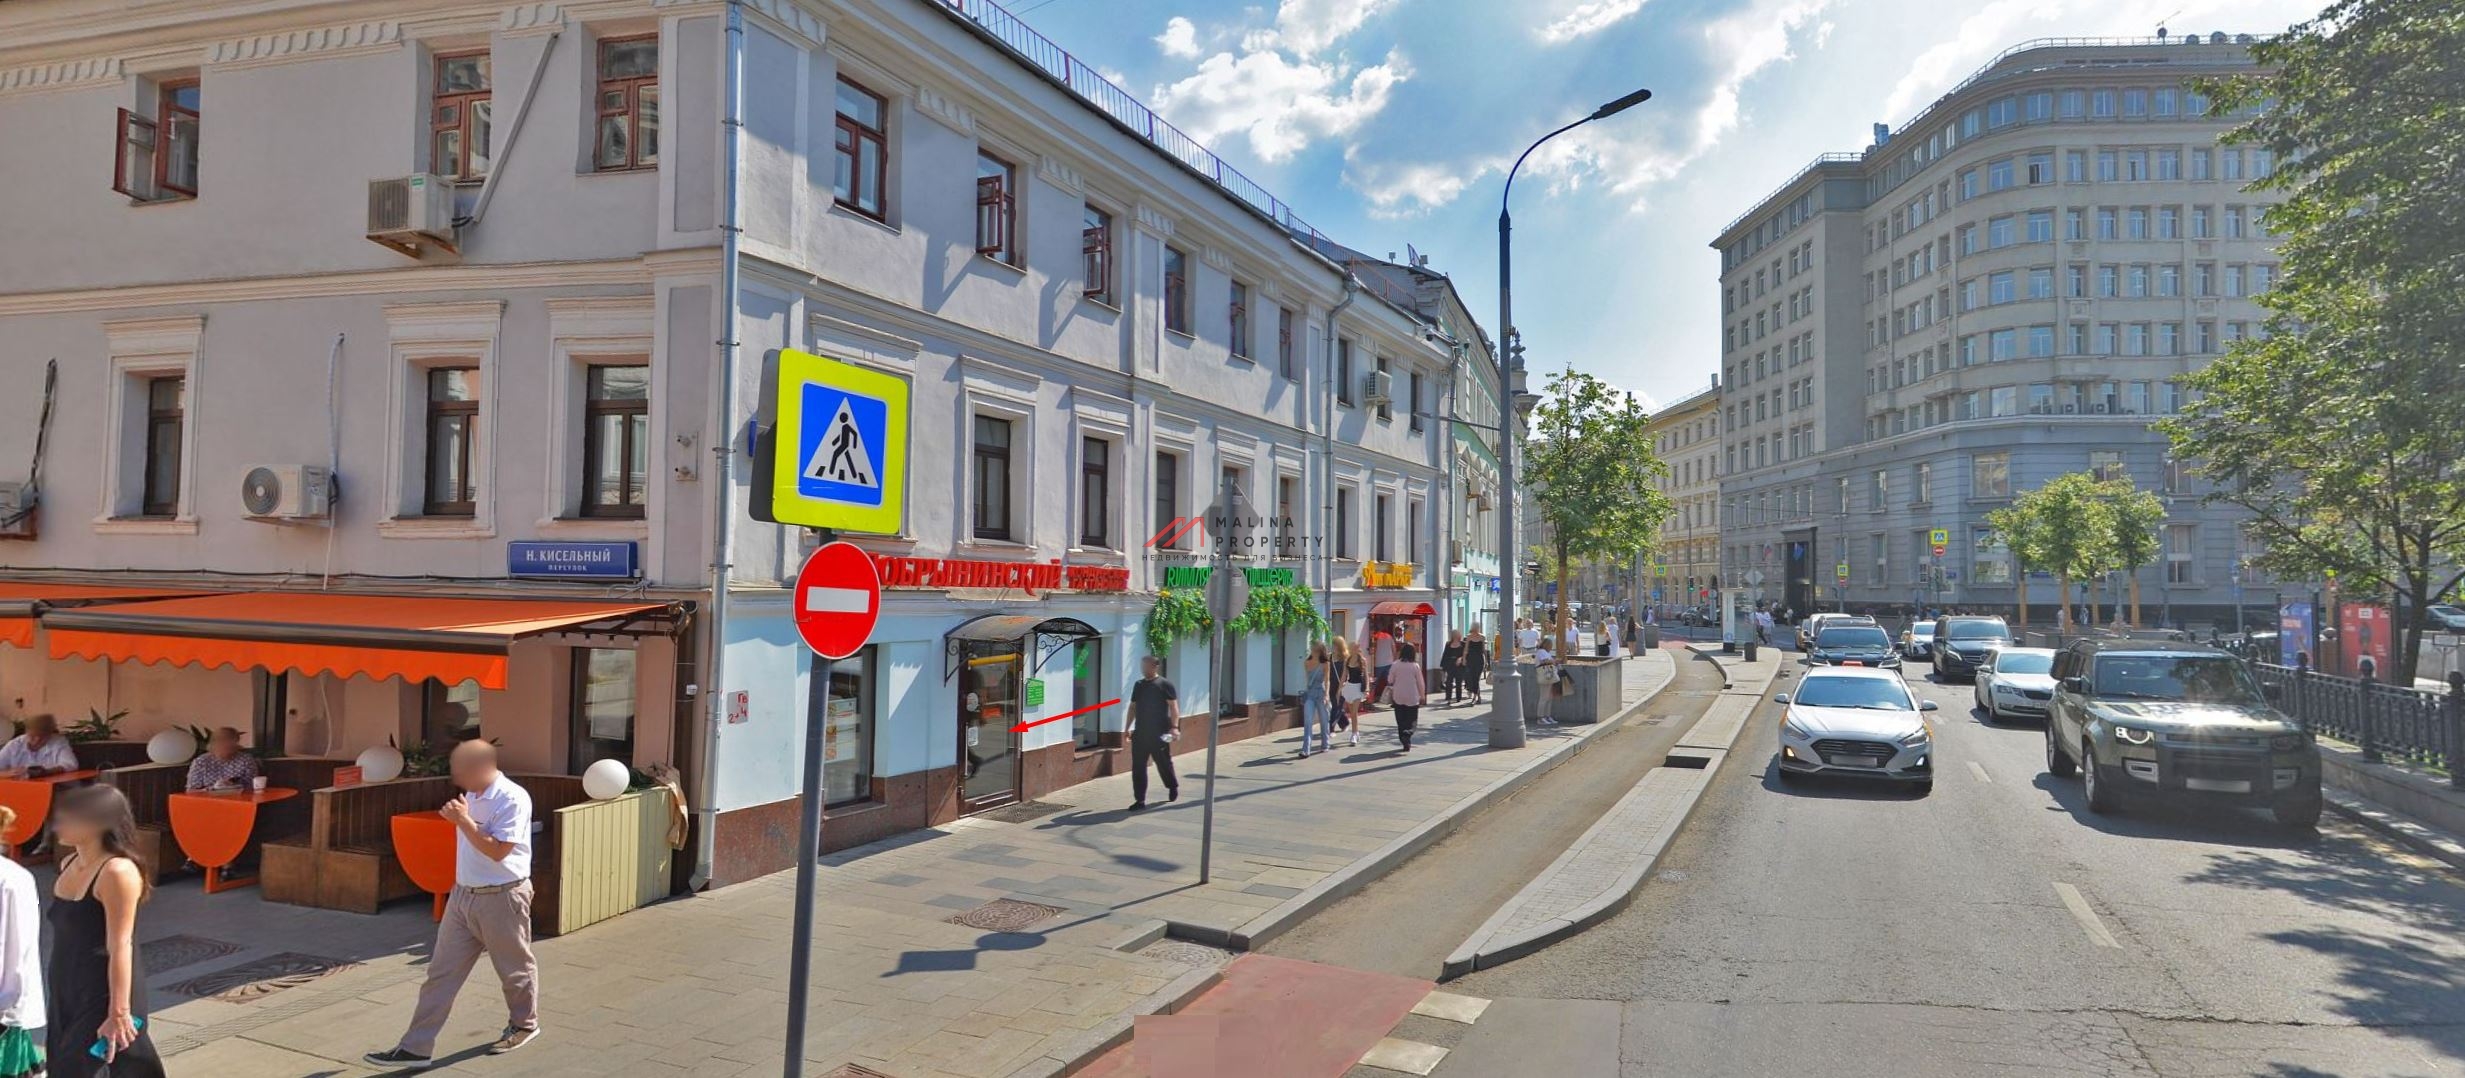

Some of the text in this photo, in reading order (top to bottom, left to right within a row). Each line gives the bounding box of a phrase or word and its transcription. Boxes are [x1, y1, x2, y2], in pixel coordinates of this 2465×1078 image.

[525, 548, 611, 562] Н. КИСЕЛЬНЫЙ
[868, 552, 1062, 596] ОБРЫНИНСКИЙ
